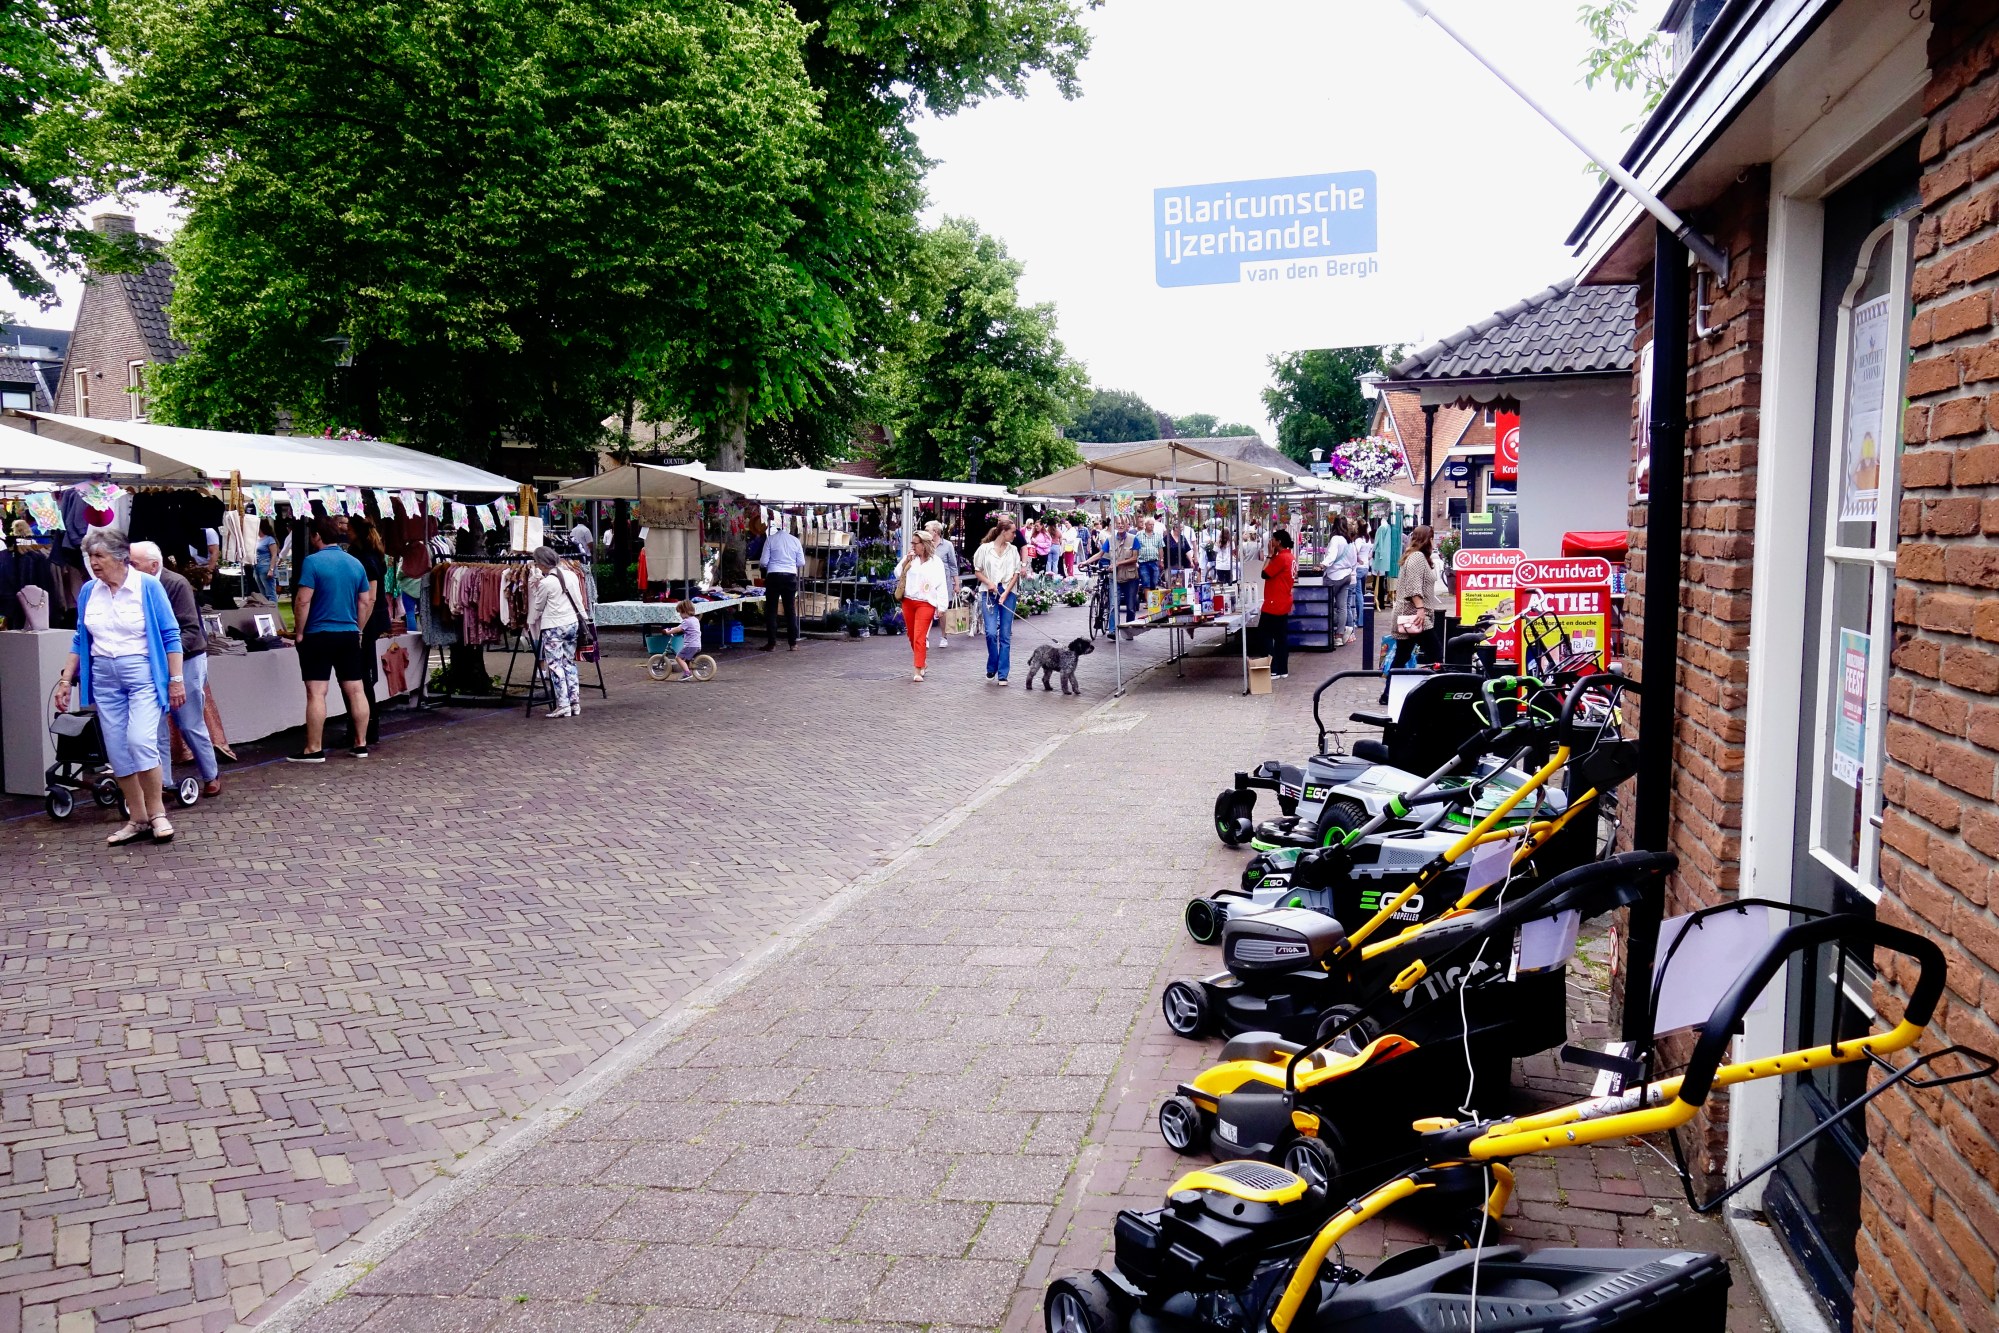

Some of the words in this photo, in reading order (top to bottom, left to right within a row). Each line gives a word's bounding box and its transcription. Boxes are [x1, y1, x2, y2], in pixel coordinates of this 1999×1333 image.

[1164, 183, 1365, 226] Blaricumsche
[1164, 217, 1331, 265] IJzerhandel
[1247, 267, 1278, 282] van
[1286, 262, 1318, 279] den
[1326, 256, 1378, 278] Bergh
[1472, 553, 1521, 565] Kruidvat
[1538, 563, 1604, 579] Kruidvat
[1845, 666, 1864, 697] FEEST
[1443, 692, 1474, 700] EGO
[1305, 786, 1329, 800] EGO
[1263, 879, 1284, 887] EGO
[1359, 890, 1425, 913] EGO
